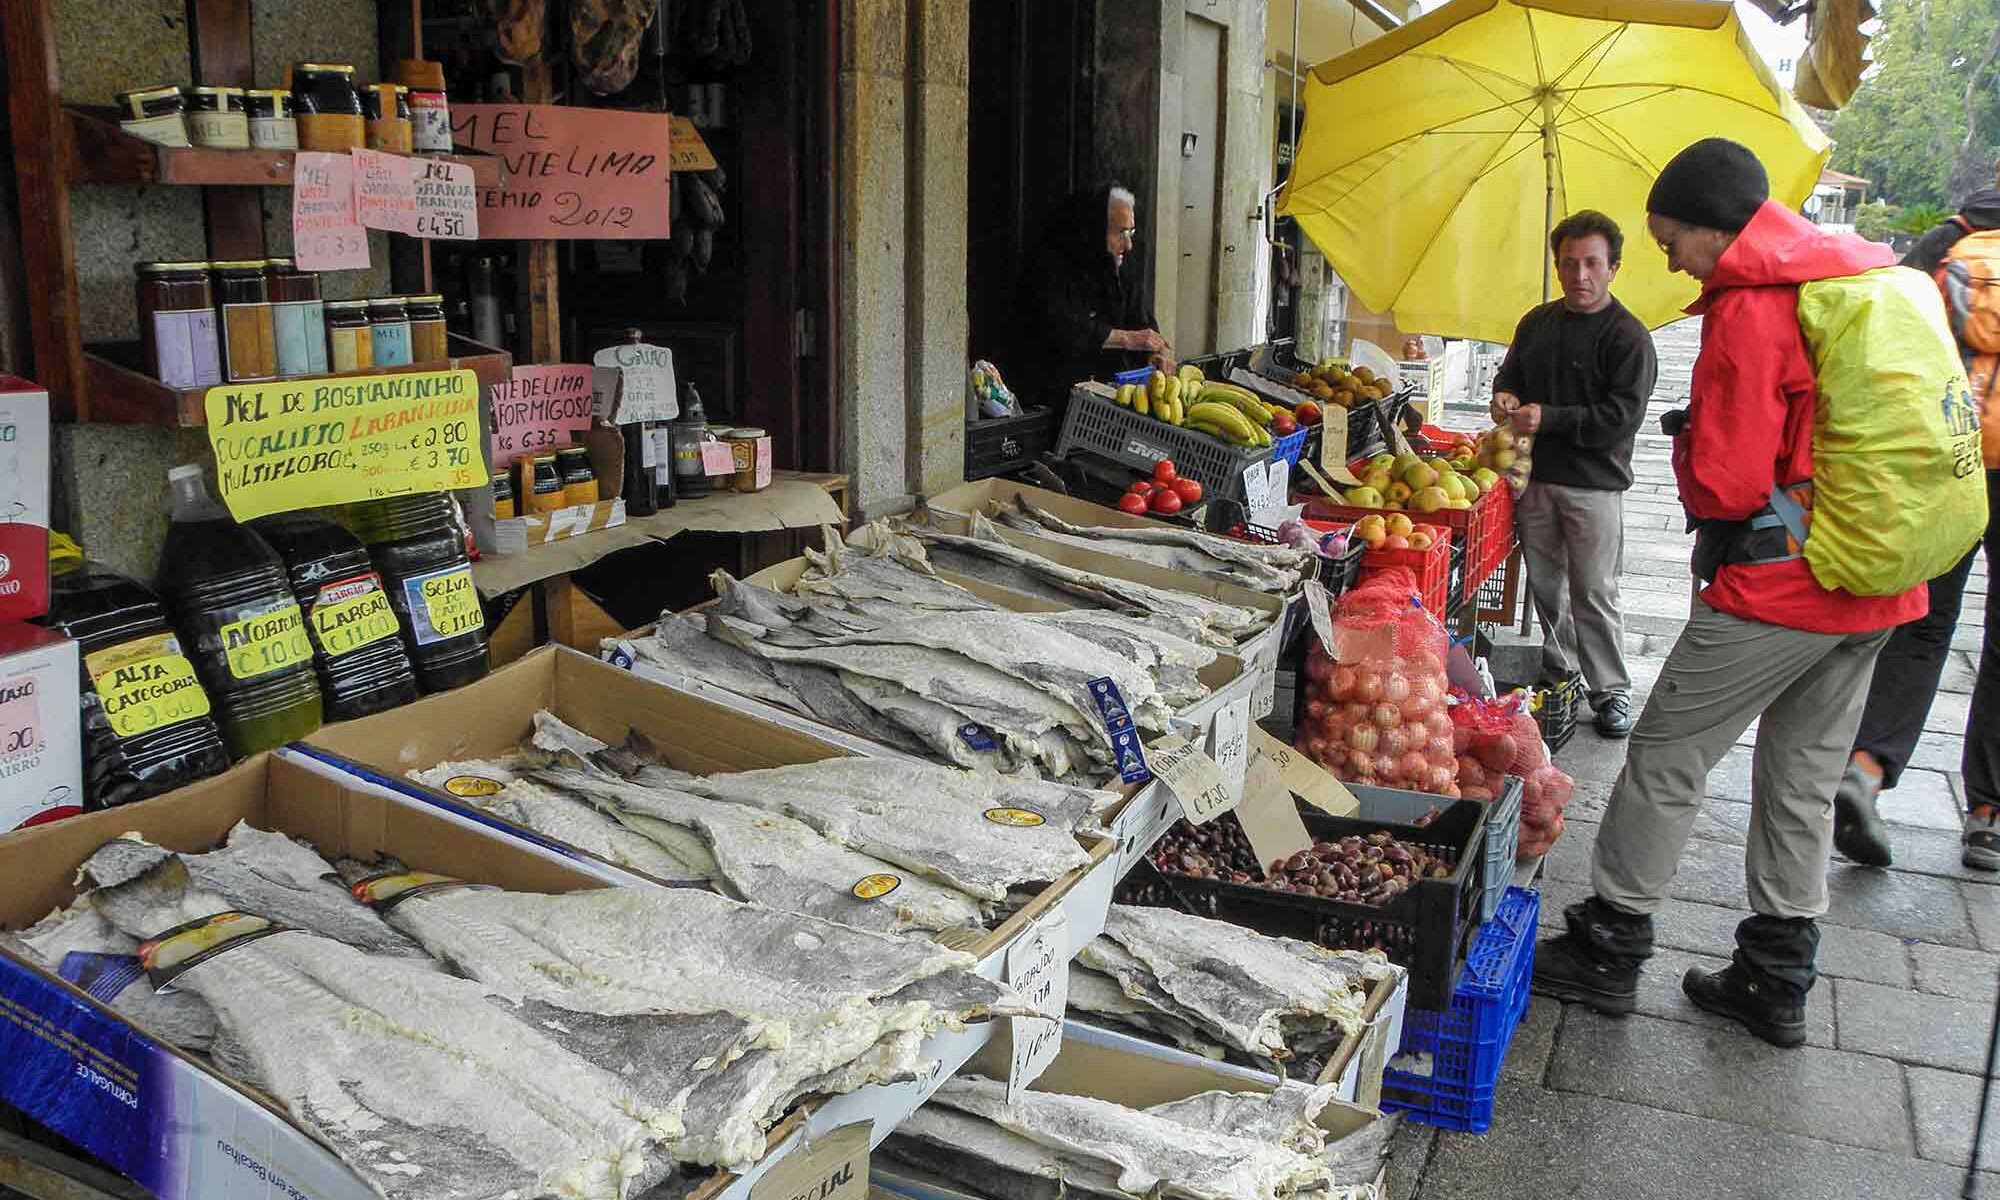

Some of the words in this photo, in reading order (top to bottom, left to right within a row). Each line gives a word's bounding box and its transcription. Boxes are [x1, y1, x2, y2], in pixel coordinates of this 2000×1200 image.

[450, 110, 548, 146] MEL
[303, 164, 330, 187] MEL
[424, 162, 454, 182] MEL
[549, 192, 634, 228] 2012
[224, 392, 268, 426] MEL
[280, 393, 304, 413] DE
[312, 374, 463, 412] ROSMANINHO
[499, 396, 592, 428] FORMIGOSO
[424, 420, 468, 447] 2.80
[522, 429, 556, 448] 6.35
[427, 446, 470, 469] 3.70
[426, 577, 470, 597] SELVA
[319, 594, 389, 634] LARGÃO
[112, 664, 168, 691] ALTA
[92, 1070, 138, 1109] PORTUGAL
[217, 1140, 266, 1181] Bacalhau
